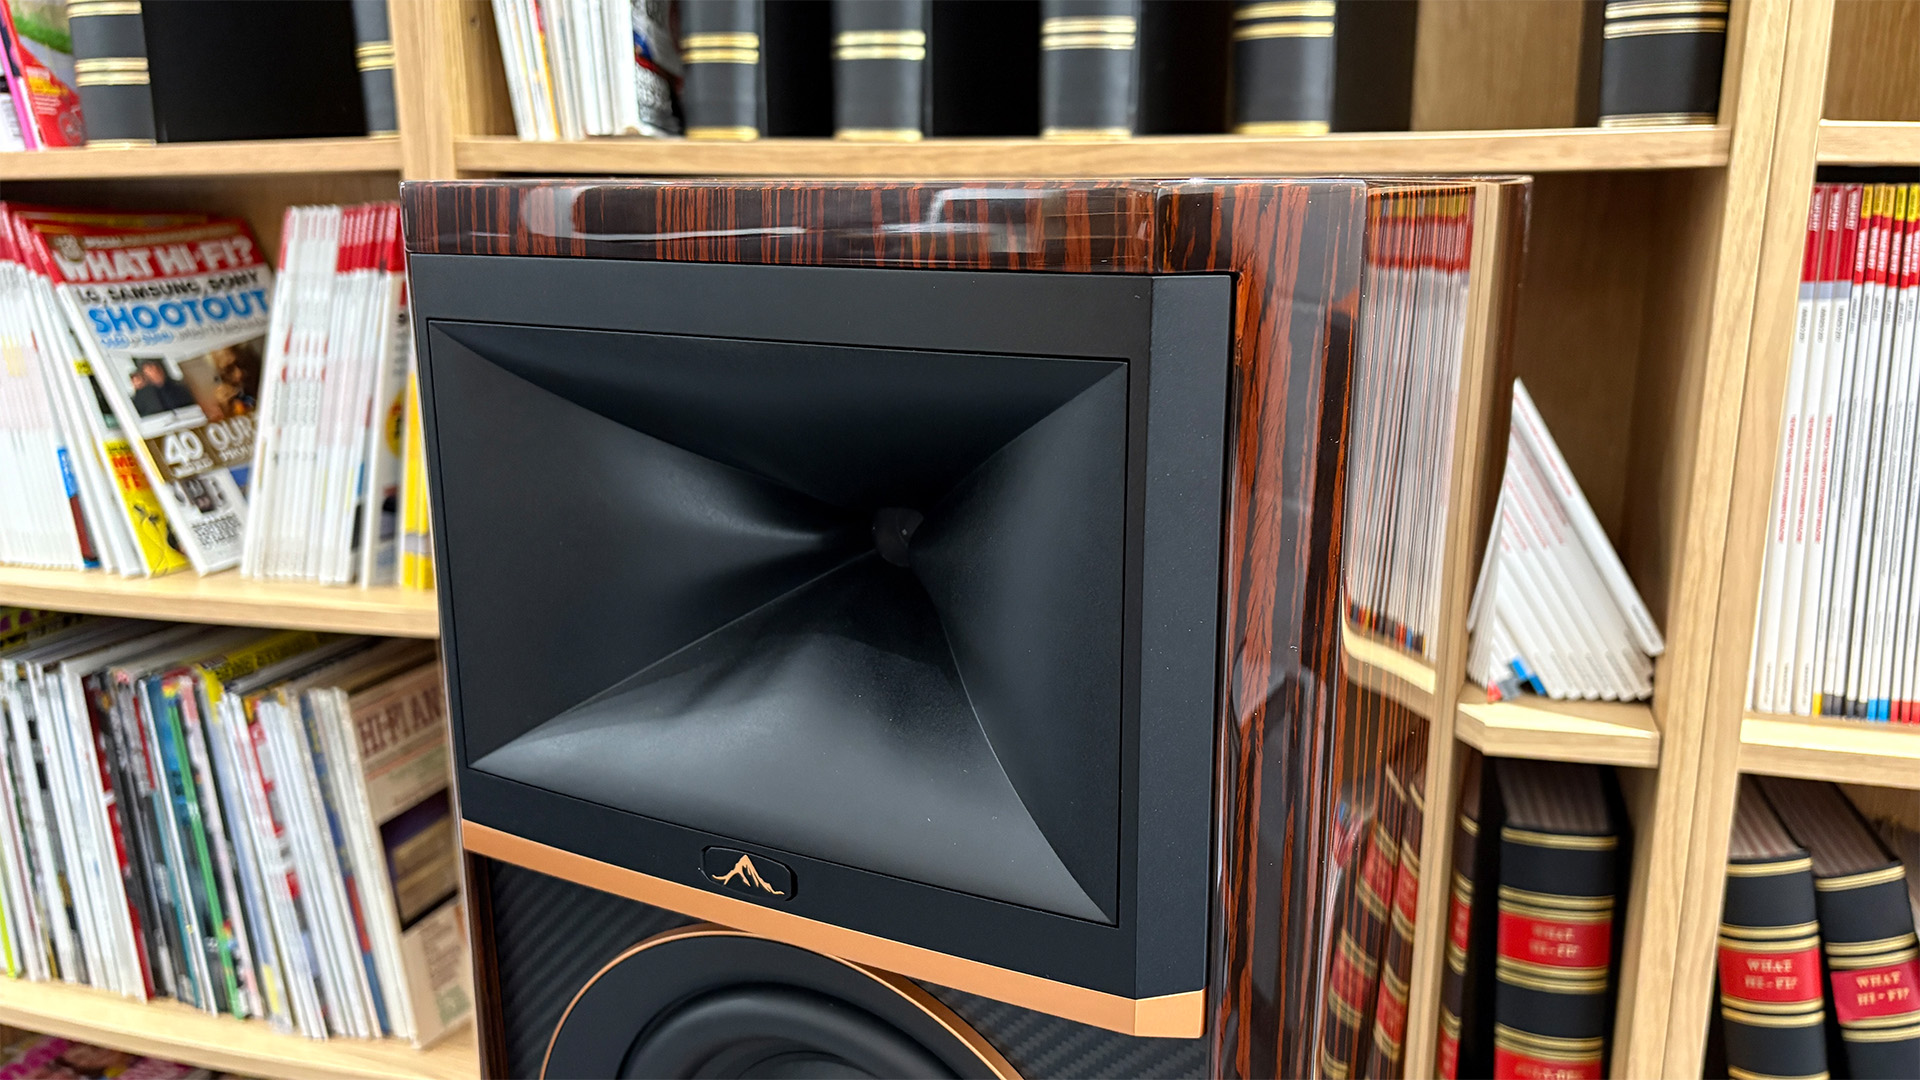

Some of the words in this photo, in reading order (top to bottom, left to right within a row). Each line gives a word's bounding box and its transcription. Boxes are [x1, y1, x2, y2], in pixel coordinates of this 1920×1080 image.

[53, 246, 154, 281] WHAT
[208, 271, 259, 291] SONY
[88, 289, 269, 333] SHOOTOUT
[164, 429, 204, 465] 40
[1746, 958, 1793, 973] WHAT
[1855, 970, 1903, 989] WHAT
